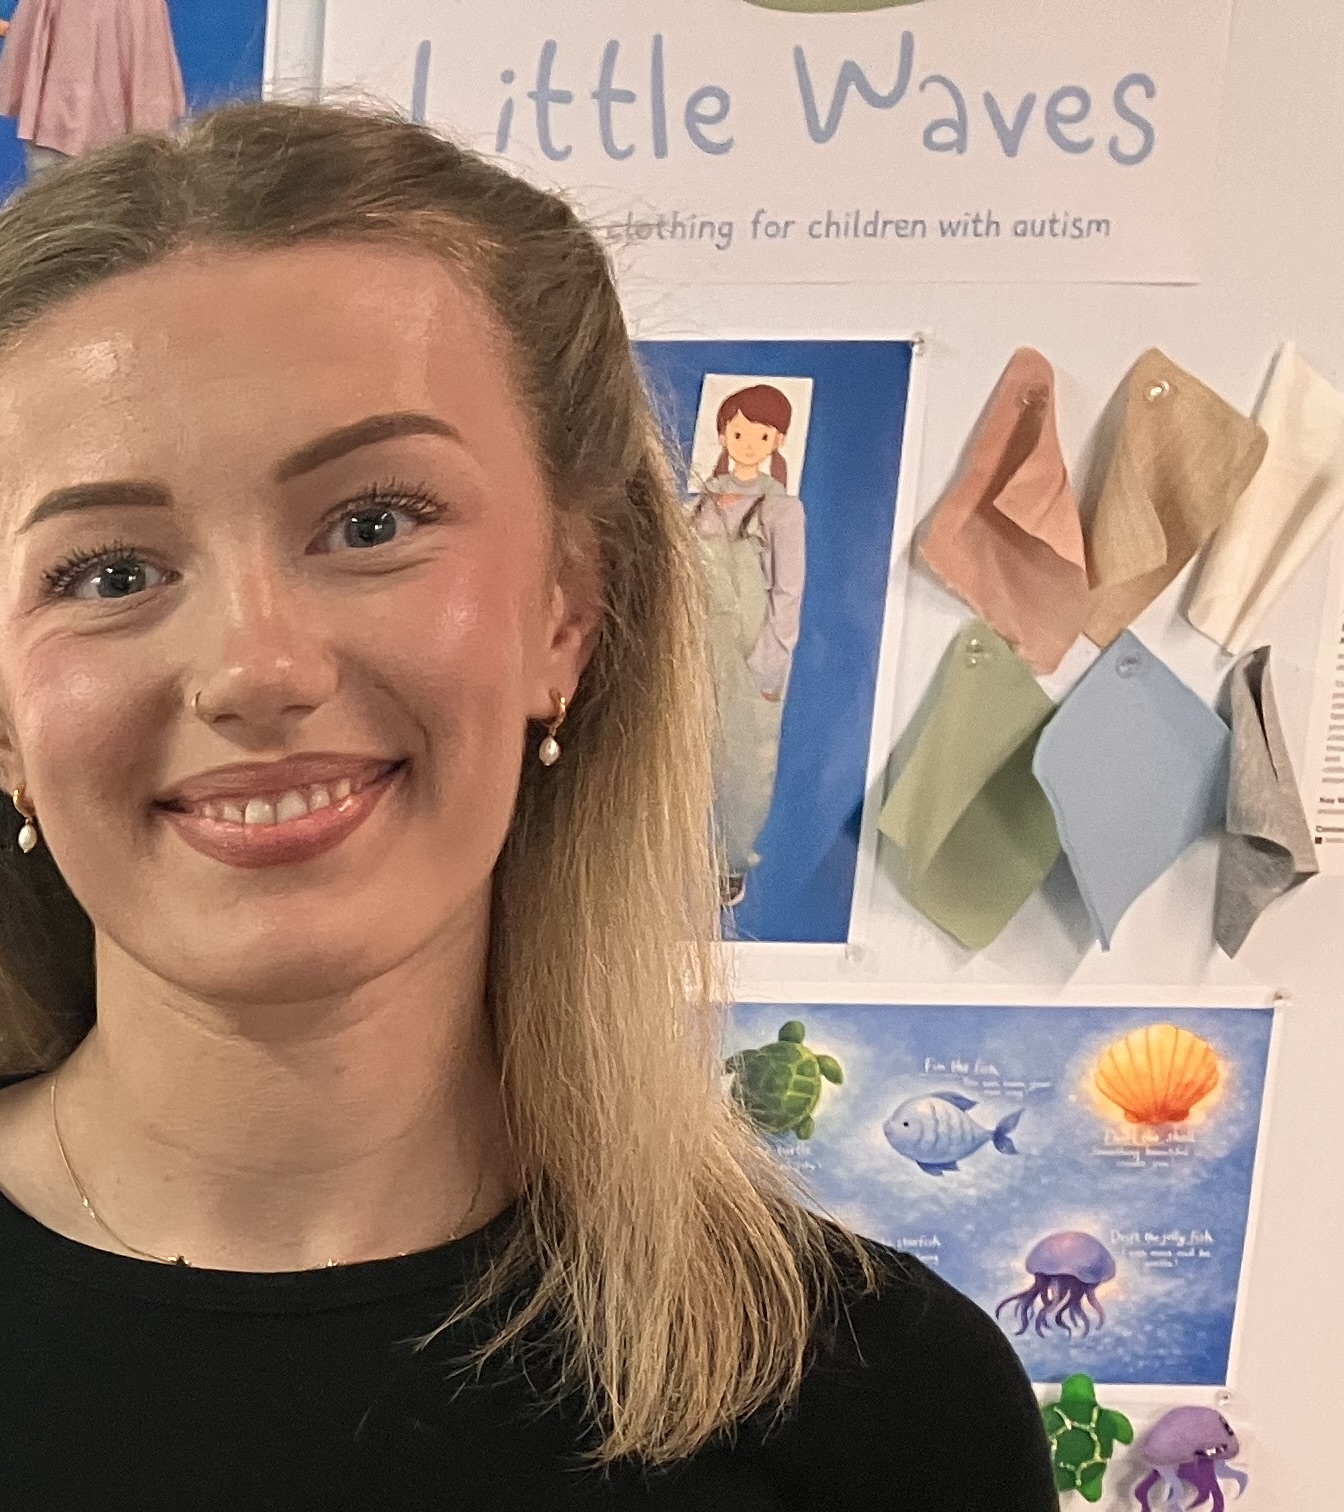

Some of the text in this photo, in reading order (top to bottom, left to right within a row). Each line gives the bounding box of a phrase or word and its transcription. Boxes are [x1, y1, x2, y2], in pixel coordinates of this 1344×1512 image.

[793, 30, 1156, 165] Waves
[751, 208, 795, 240] for
[807, 209, 927, 239] children
[938, 210, 1002, 239] with
[1012, 211, 1111, 239] autism
